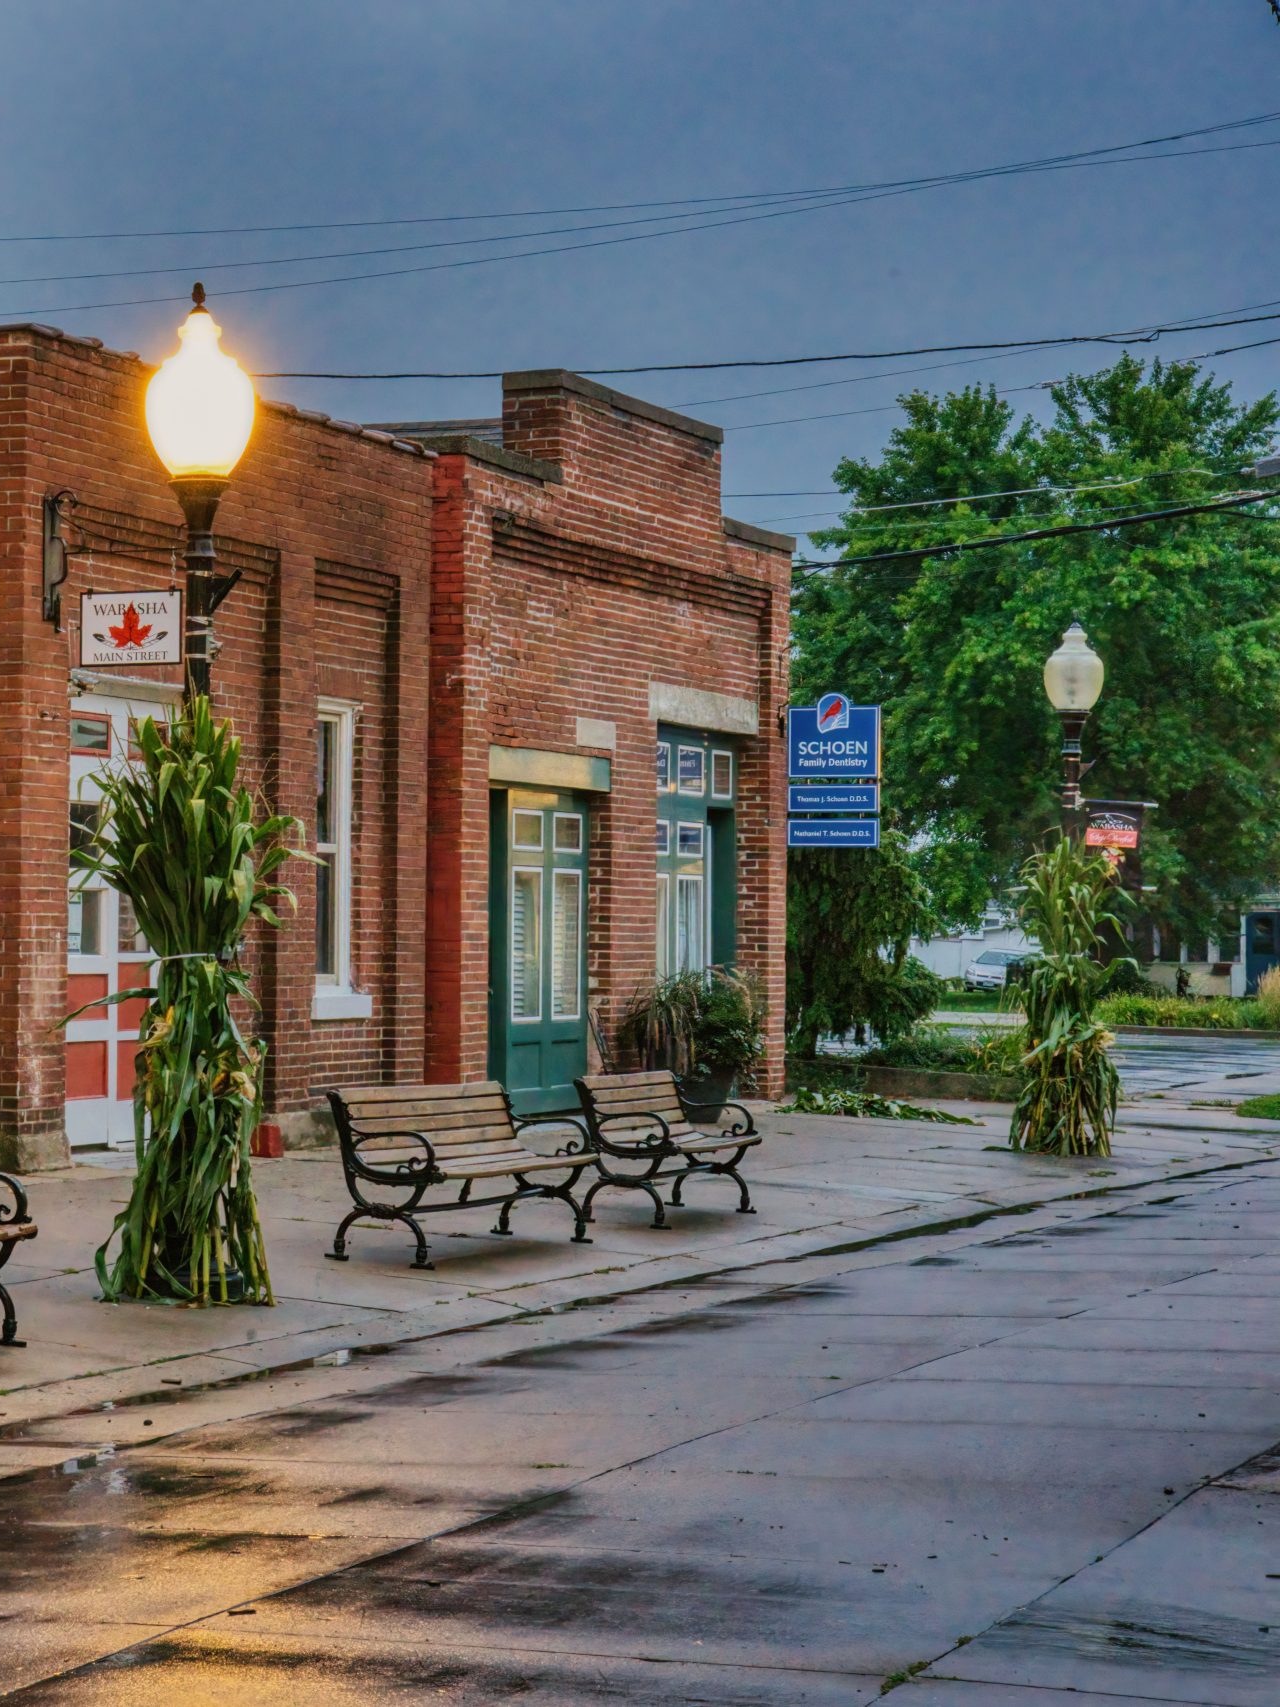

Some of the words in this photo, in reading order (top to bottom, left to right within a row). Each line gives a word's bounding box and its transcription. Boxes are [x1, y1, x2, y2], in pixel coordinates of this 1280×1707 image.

[93, 602, 168, 616] WABSHA
[93, 652, 124, 662] MAIN
[126, 651, 168, 661] STREET
[798, 741, 868, 755] SCHOEN
[798, 758, 826, 768] Family
[828, 758, 868, 768] Dentistry
[1090, 823, 1134, 831] WABASHA
